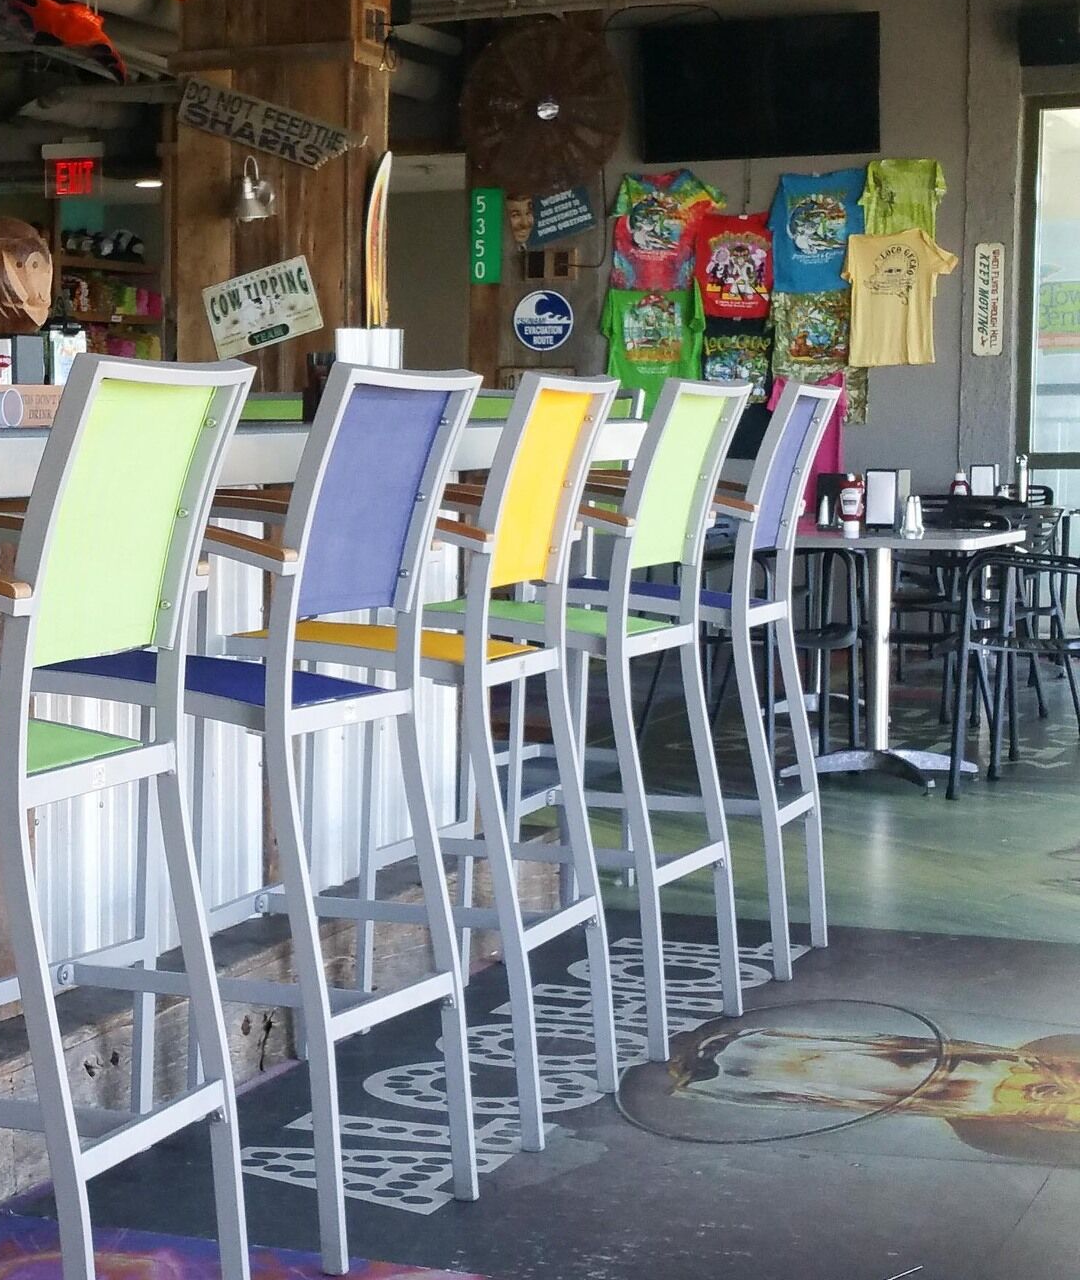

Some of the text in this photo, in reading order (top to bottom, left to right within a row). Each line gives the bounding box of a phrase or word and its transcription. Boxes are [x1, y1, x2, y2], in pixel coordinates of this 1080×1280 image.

[185, 81, 211, 104] DO
[216, 92, 259, 119] NOT
[264, 106, 311, 140] FEED
[184, 102, 324, 166] SHARKS
[56, 161, 94, 195] EXIT
[880, 246, 902, 260] LOCO
[210, 266, 310, 325] COW TIPPING
[977, 252, 990, 337] KEEP MOVING
[524, 325, 563, 335] EVACUATION
[533, 336, 554, 345] ROUTE
